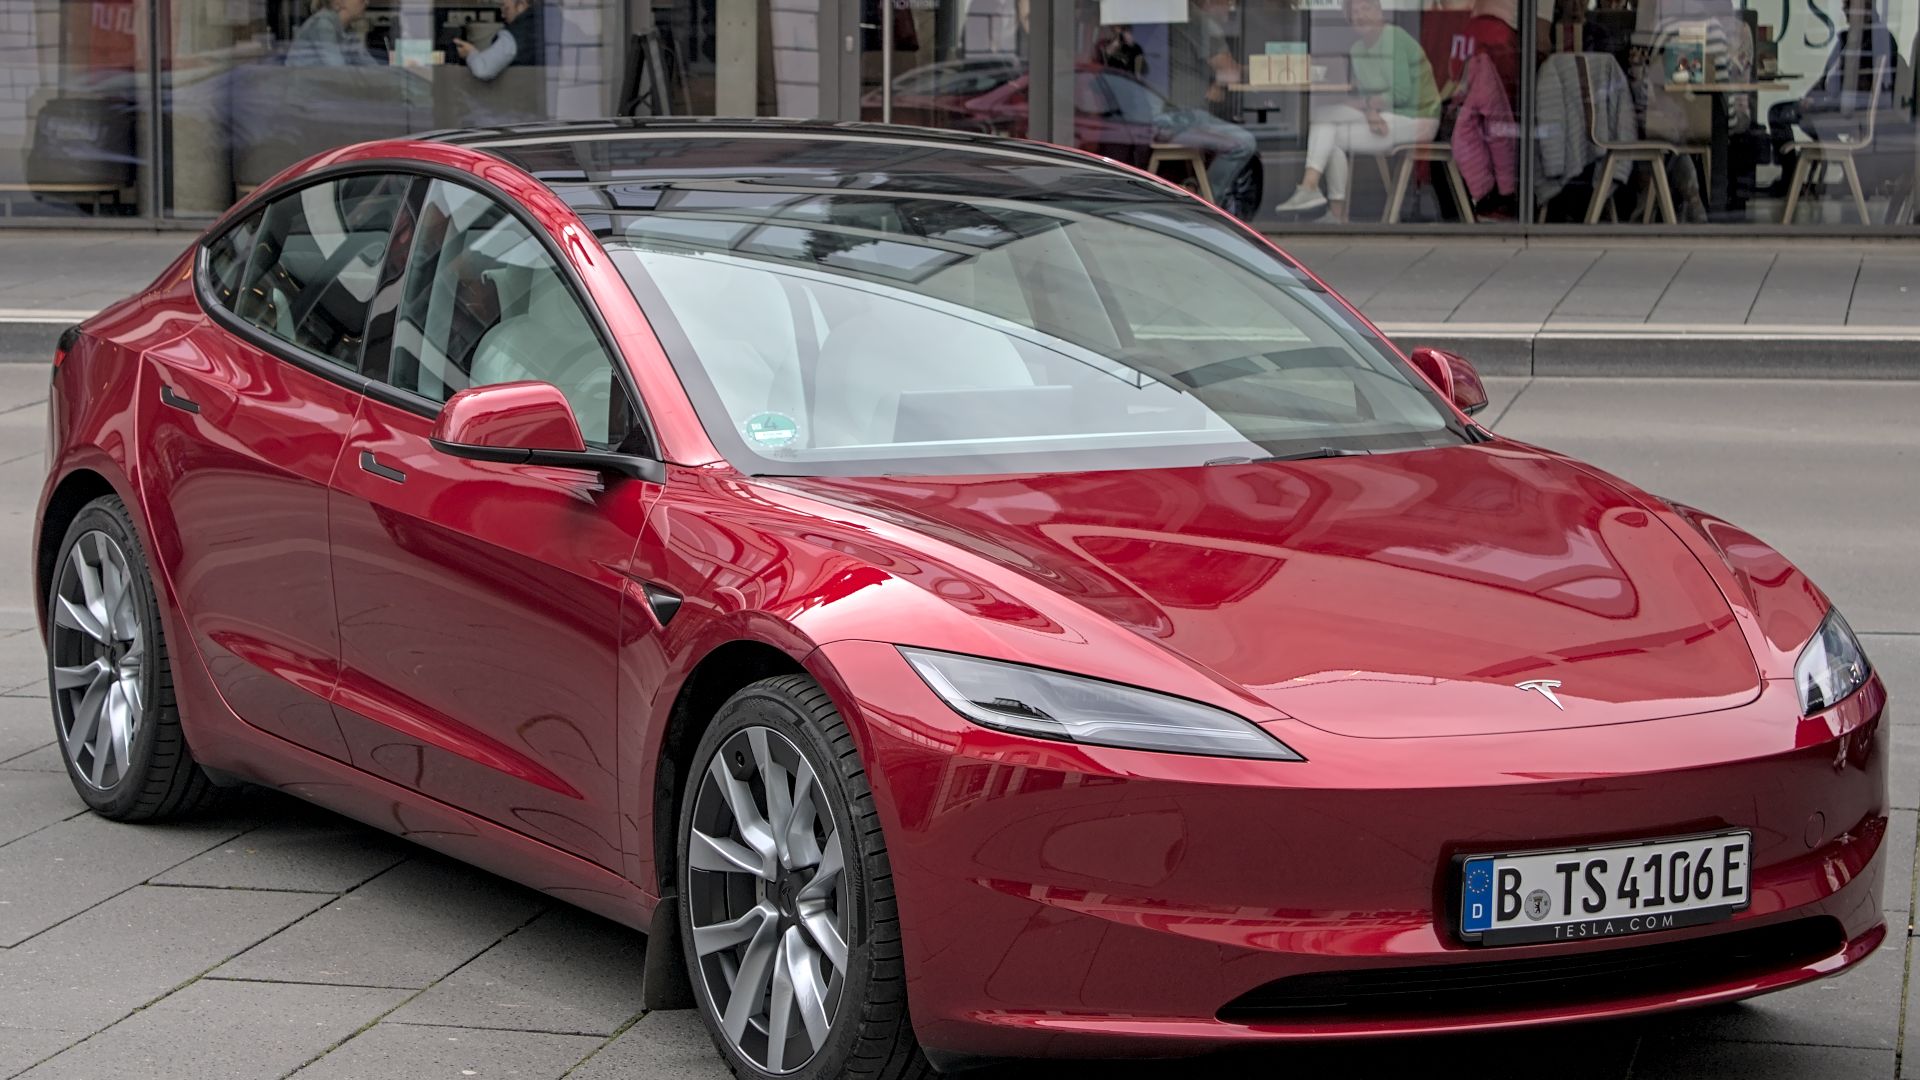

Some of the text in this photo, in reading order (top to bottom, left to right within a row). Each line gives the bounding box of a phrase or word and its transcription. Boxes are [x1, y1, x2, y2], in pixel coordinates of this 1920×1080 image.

[1496, 866, 1522, 922] B
[1472, 903, 1483, 919] D
[1554, 915, 1673, 939] TESLA.COM
